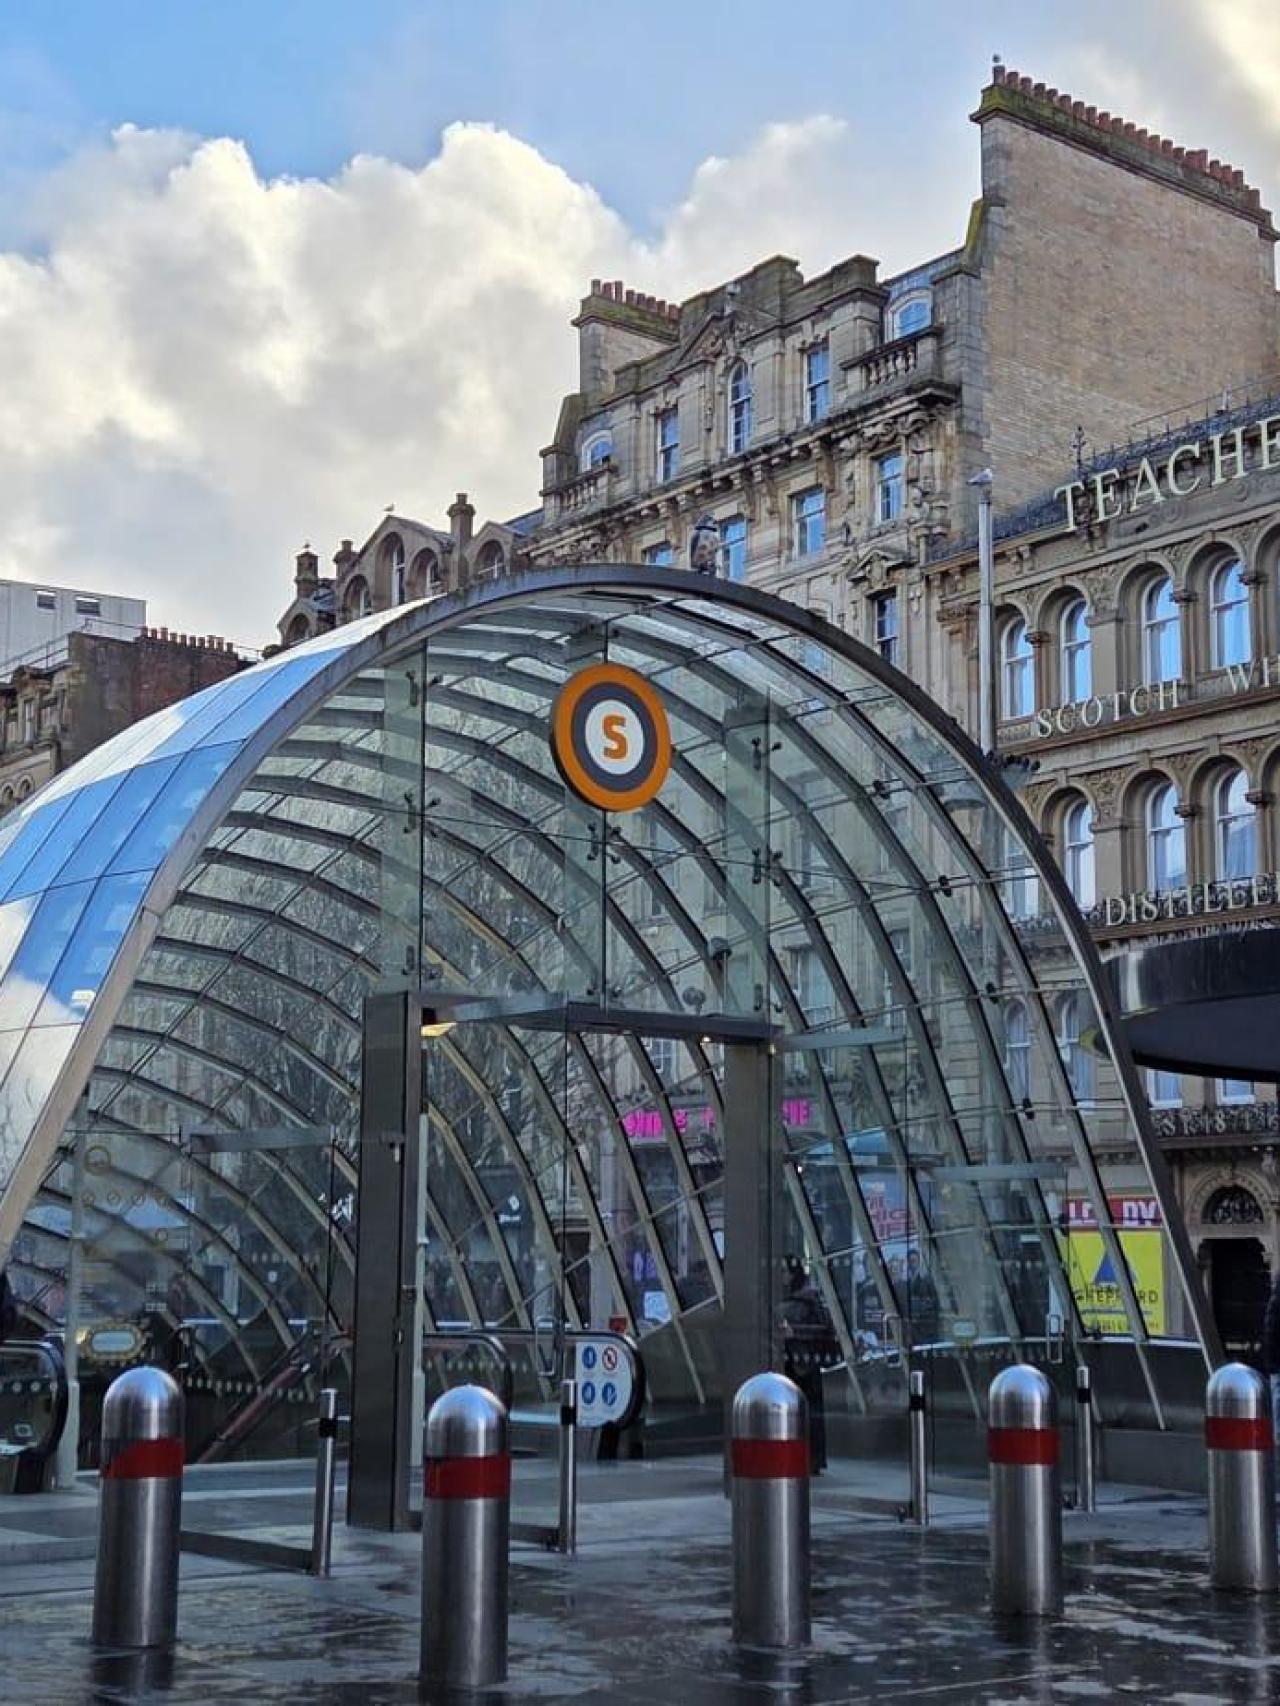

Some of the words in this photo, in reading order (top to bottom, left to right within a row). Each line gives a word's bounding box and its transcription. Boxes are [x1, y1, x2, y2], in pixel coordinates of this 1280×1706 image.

[1054, 415, 1280, 532] TEACHE
[1037, 679, 1179, 738] SCOTCH
[603, 714, 628, 760] S
[1105, 872, 1280, 926] DISTILLE
